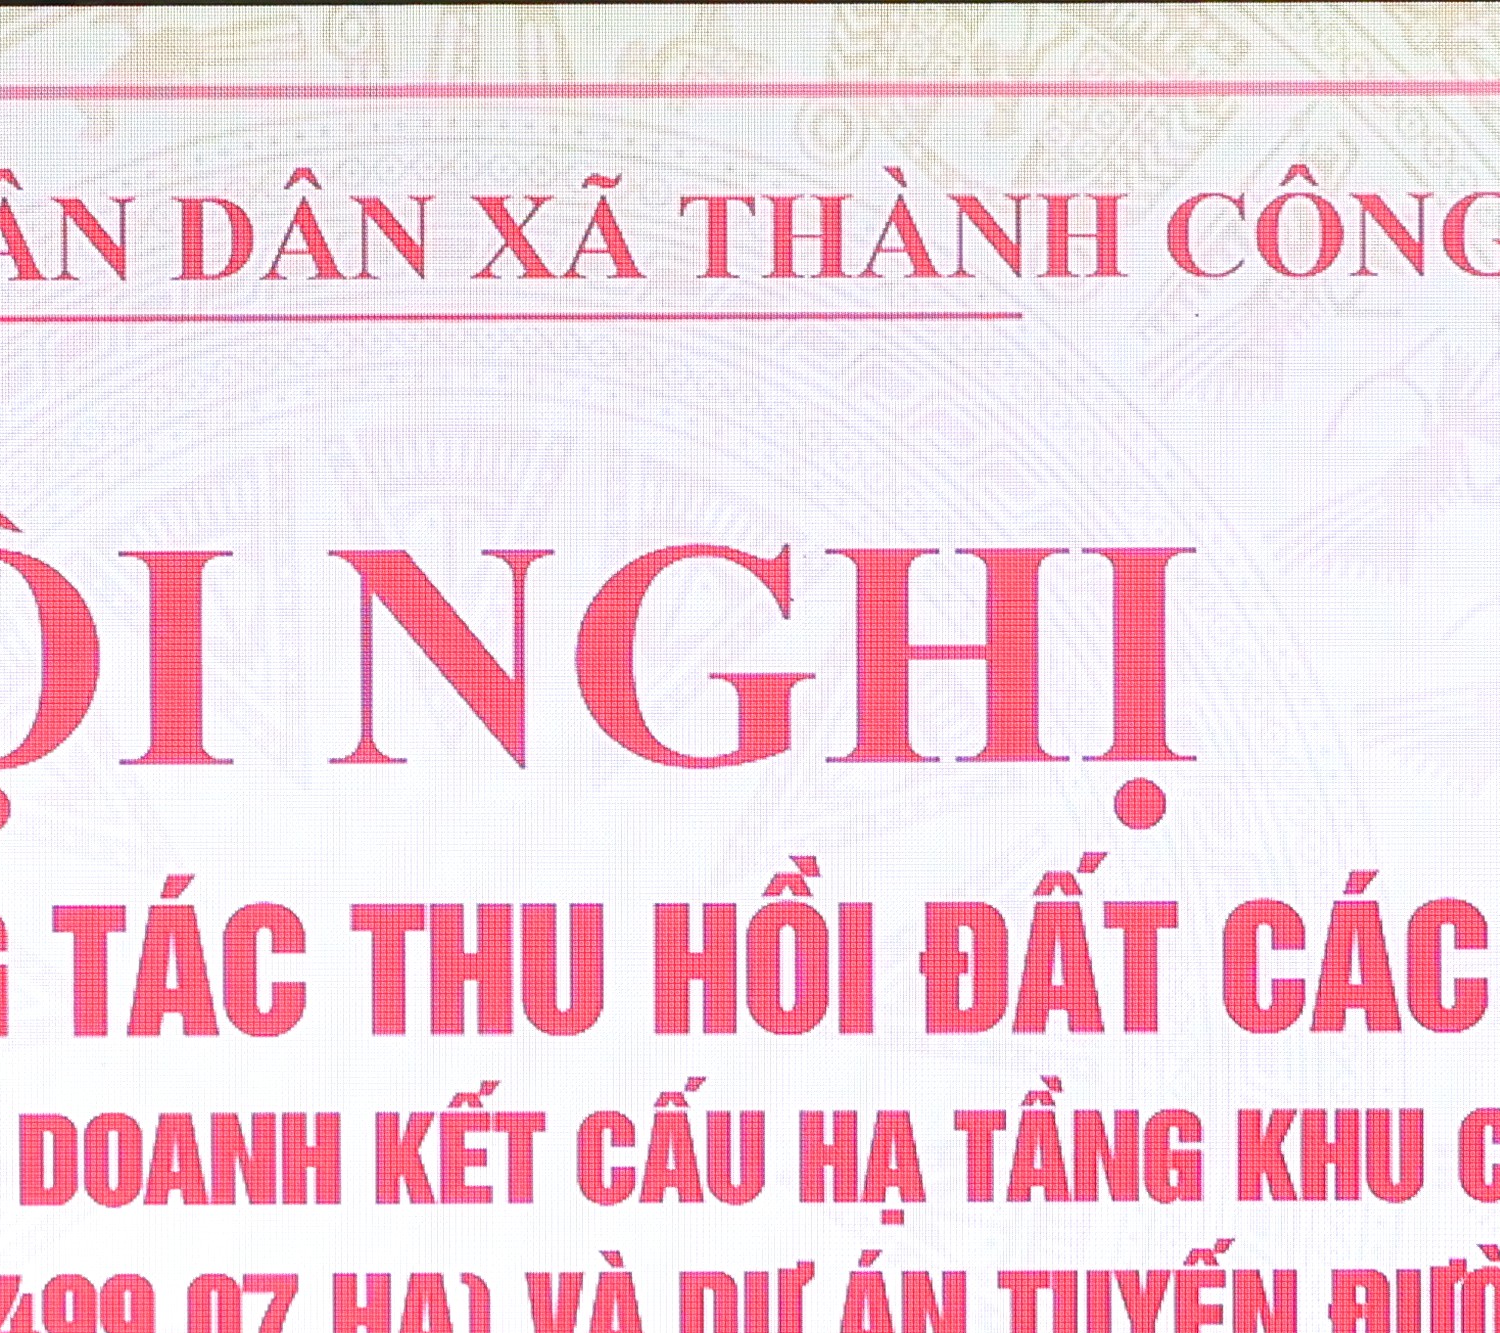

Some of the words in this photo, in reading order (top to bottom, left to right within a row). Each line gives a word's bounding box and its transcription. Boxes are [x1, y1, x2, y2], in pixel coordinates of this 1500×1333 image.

[177, 168, 432, 280] DÂN
[475, 175, 642, 279] XÃ
[681, 167, 1121, 278] THÀNH
[332, 544, 1194, 830] NGHỊ
[53, 875, 306, 1037] TÁC
[351, 903, 604, 1036] THU
[655, 856, 874, 1035] HỒI
[920, 852, 1178, 1034] ĐẤT
[1224, 870, 1488, 1034] CÁC
[20, 1112, 341, 1208] DOANH
[376, 1081, 546, 1204] KẾT
[578, 1077, 765, 1206] CẤU
[800, 1110, 926, 1225] HẠ
[955, 1076, 1203, 1204] TẦNG
[1237, 1108, 1424, 1203] KHU
